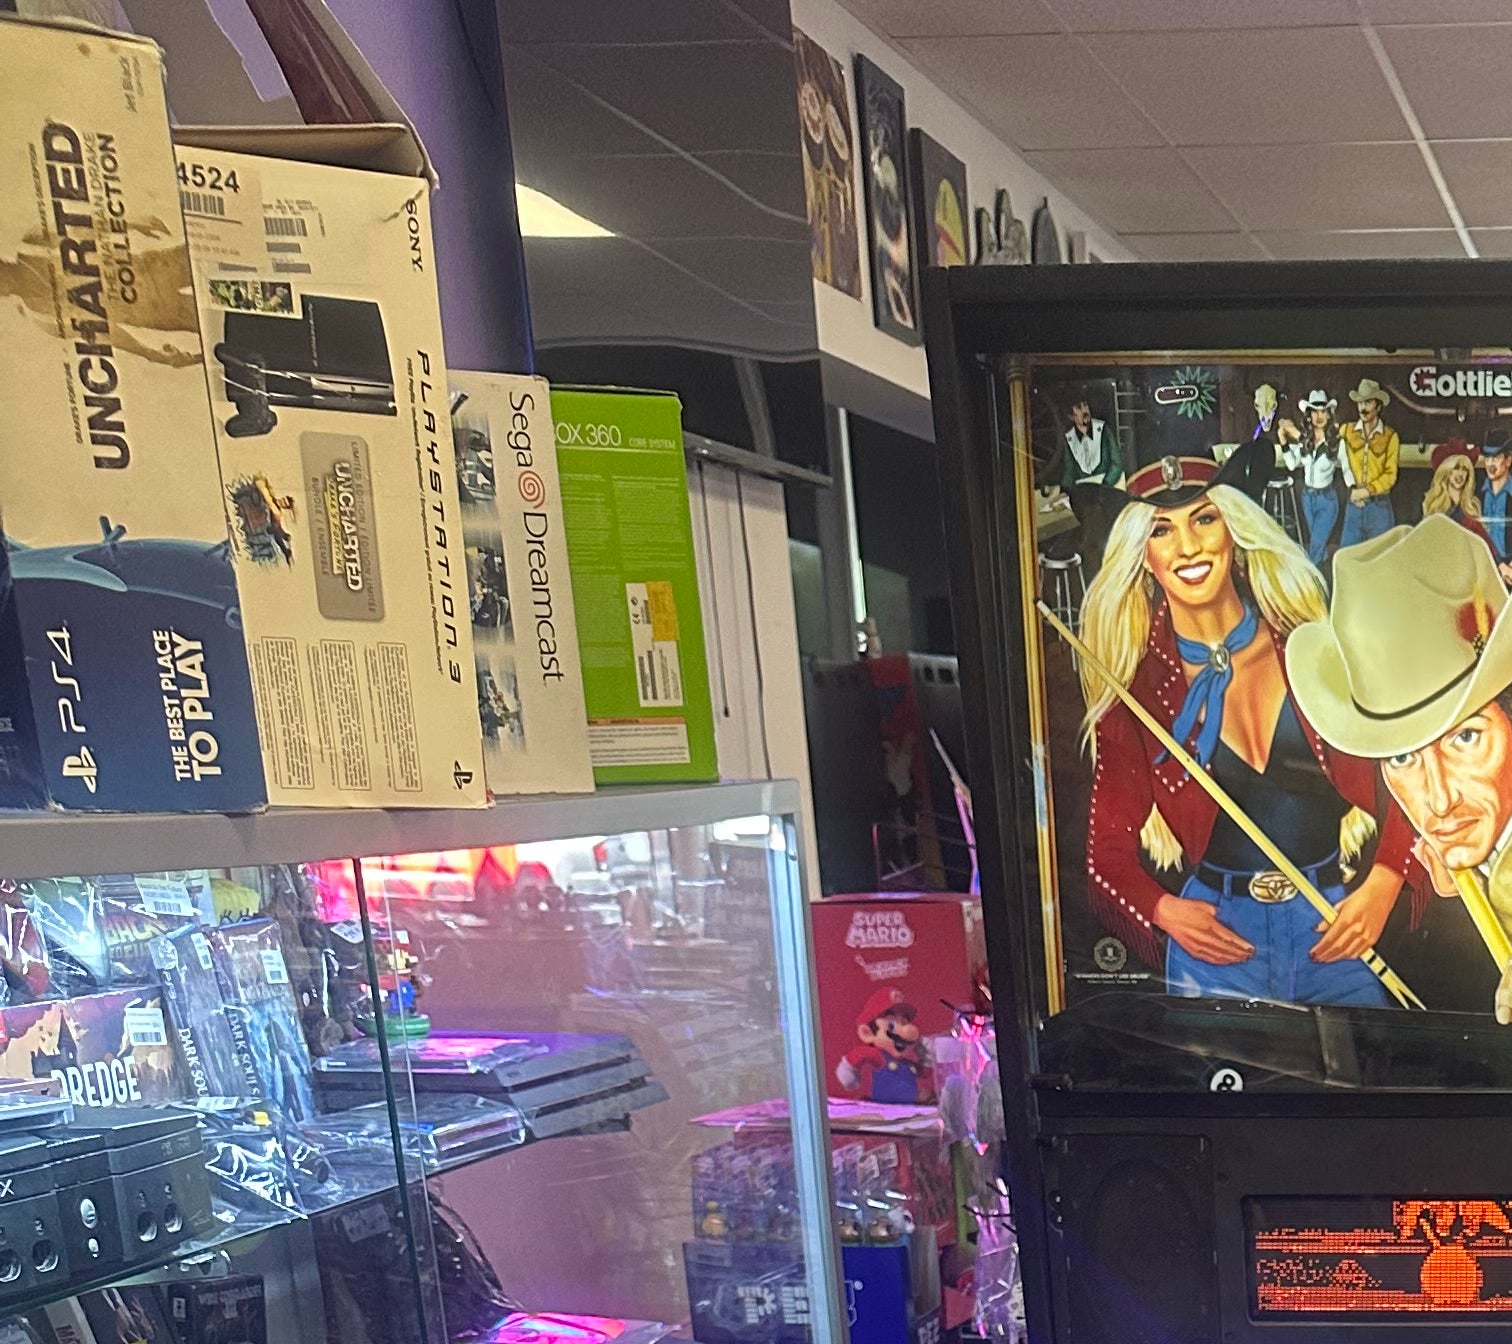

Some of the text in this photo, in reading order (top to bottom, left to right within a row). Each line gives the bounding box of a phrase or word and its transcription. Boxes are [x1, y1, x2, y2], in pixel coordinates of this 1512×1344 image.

[82, 131, 120, 302] THE NATHAN DRAKE
[97, 132, 138, 304] COLLECTION
[405, 199, 424, 272] SONY
[43, 122, 130, 469] UNCHARTED
[586, 424, 622, 447] 360
[334, 461, 364, 590] UNCHARTED
[416, 349, 462, 684] PLAYSTATION 3
[506, 391, 566, 685] Sega Dreamcast
[47, 626, 86, 733] PS4
[153, 629, 193, 782] THE BEST PLACE
[172, 631, 222, 782] TO PLAY
[846, 926, 915, 948] MARIO
[853, 911, 906, 928] SUPER
[50, 1056, 142, 1109] DREDGE
[179, 1026, 196, 1061] DARK
[229, 1011, 246, 1049] DARK
[736, 1285, 813, 1325] PE
